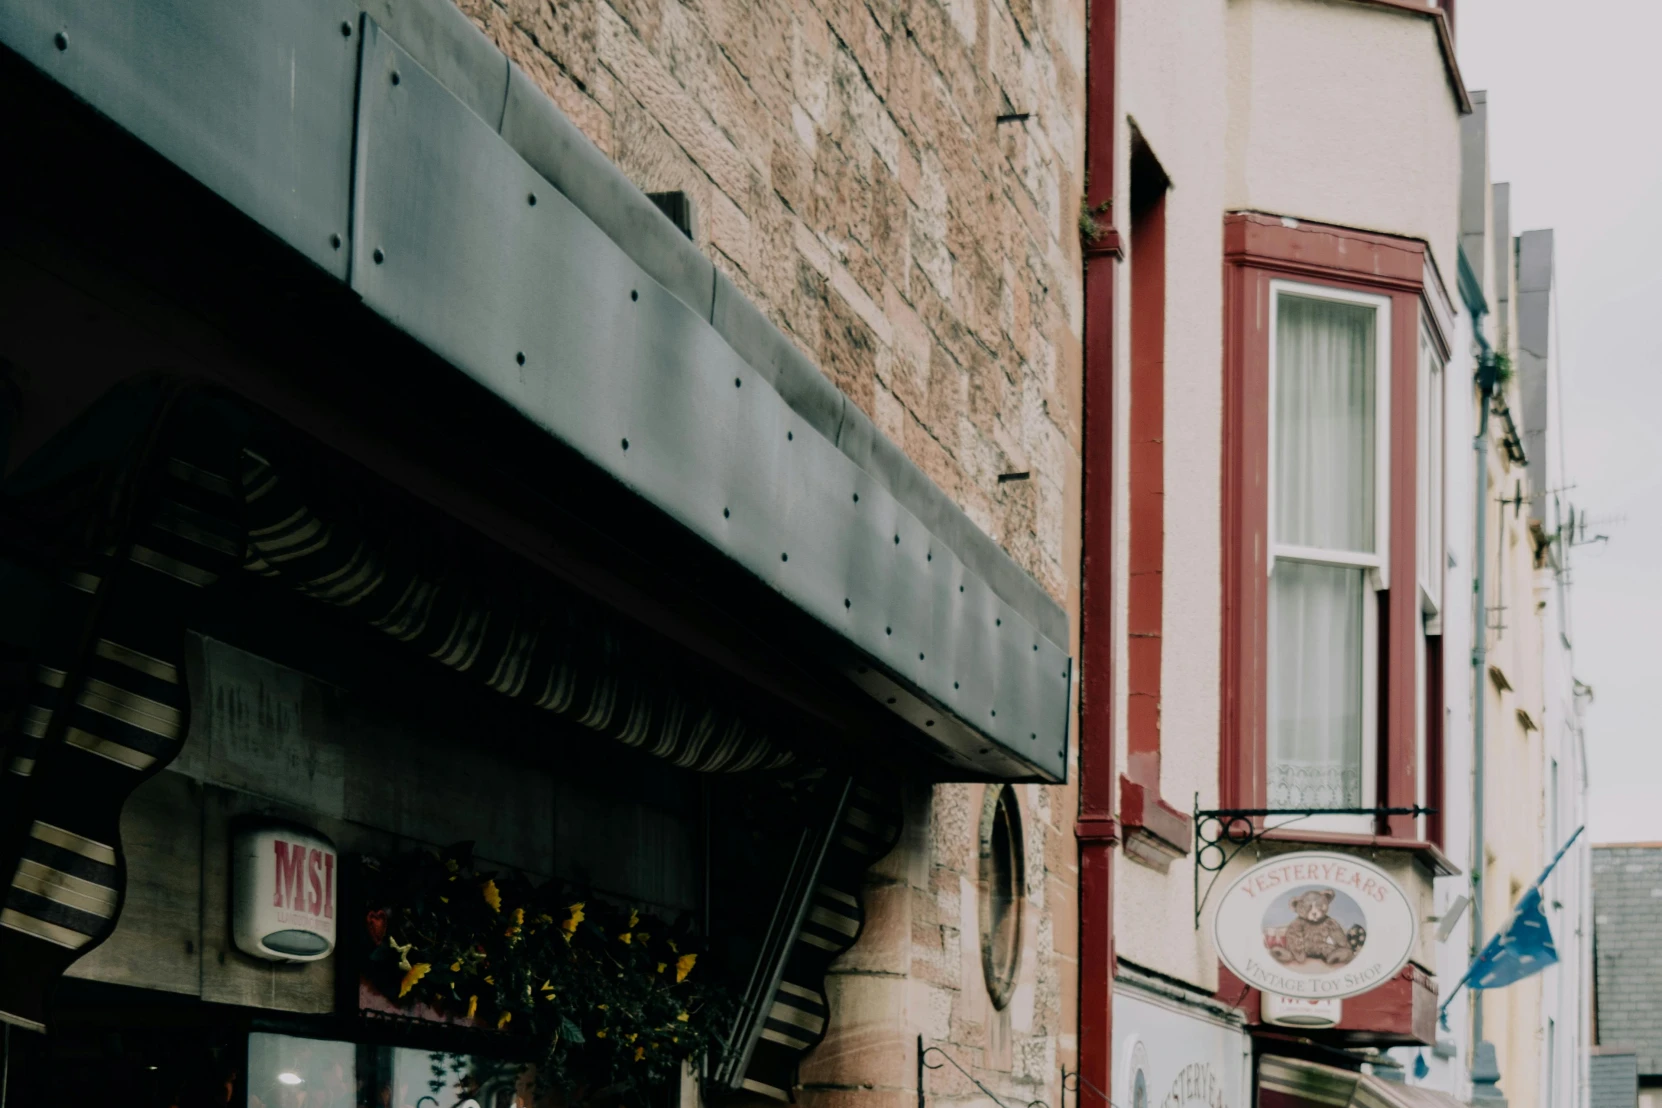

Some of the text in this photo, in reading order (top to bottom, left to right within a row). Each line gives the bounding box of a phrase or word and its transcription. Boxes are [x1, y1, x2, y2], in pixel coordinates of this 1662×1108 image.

[274, 840, 334, 919] MSI
[1241, 864, 1388, 902] YESTERYEARS
[1245, 959, 1383, 992] VINTAGE TOY SHOP
